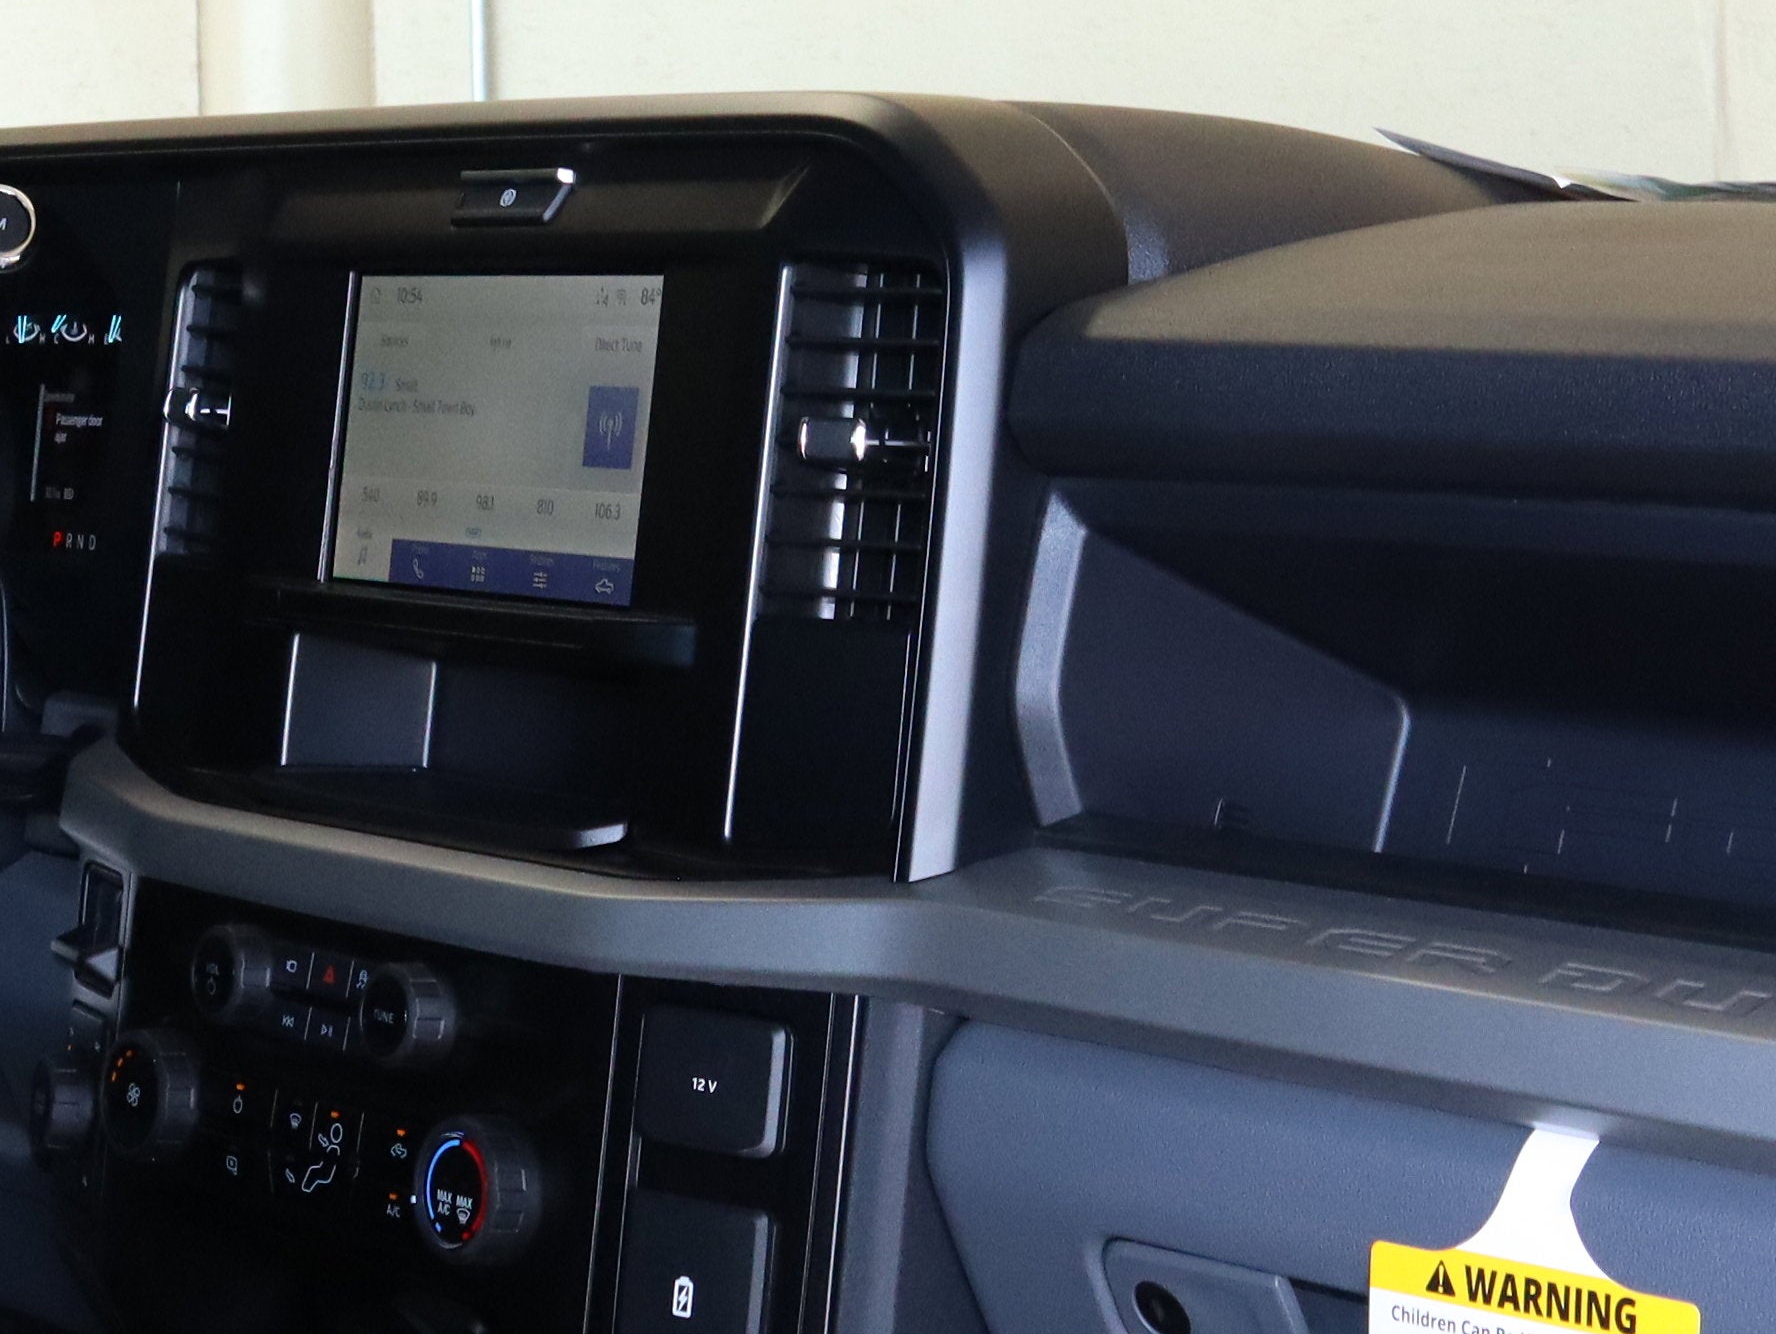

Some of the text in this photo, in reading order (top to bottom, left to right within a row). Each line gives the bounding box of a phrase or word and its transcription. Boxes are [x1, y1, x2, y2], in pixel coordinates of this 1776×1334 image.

[396, 287, 423, 305] 10:54
[1032, 882, 1514, 974] SUPER
[692, 1077, 718, 1093] 12 V
[437, 1188, 453, 1203] MAX
[456, 1194, 473, 1209] MAX
[1391, 1305, 1456, 1333] Children
